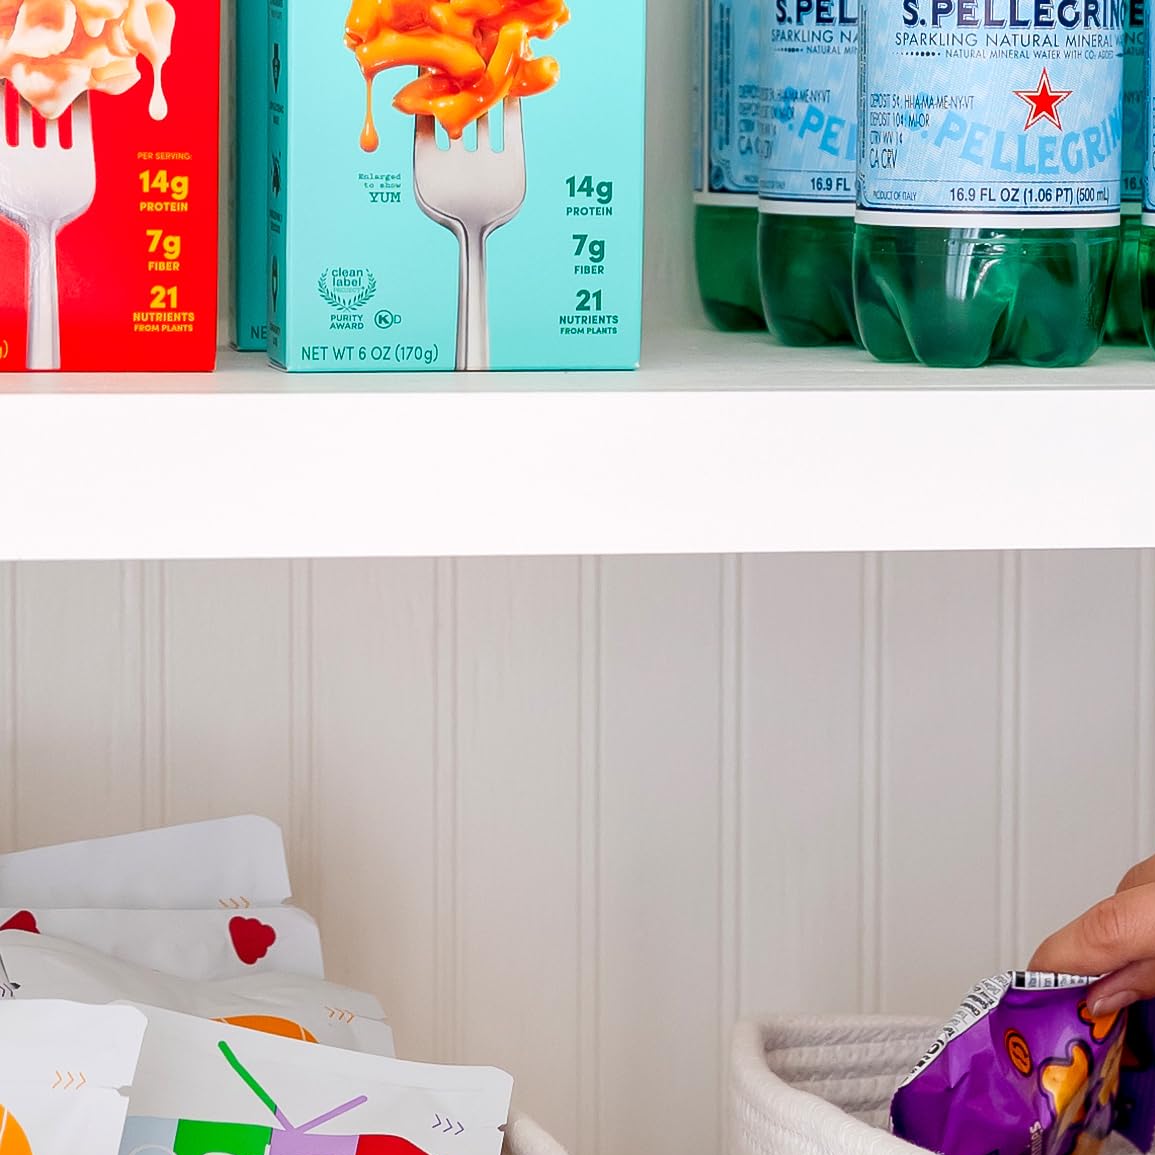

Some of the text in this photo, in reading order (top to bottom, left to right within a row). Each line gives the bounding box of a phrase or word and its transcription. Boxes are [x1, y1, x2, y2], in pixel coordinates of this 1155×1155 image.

[771, 29, 834, 43] SPARKLING
[895, 32, 978, 46] SPARKLING
[986, 33, 1059, 48] NATURAL
[1066, 34, 1112, 48] MINERAL
[806, 46, 840, 54] NATURAL
[945, 49, 986, 59] NATURAL
[990, 49, 1029, 59] MINERAL
[1033, 49, 1060, 59] WATER
[1064, 49, 1081, 59] WITH
[138, 152, 153, 160] PER
[358, 173, 401, 181] Enlarged
[139, 170, 189, 201] 14g
[810, 177, 850, 191] 16.9 FL
[566, 176, 613, 204] 14g
[369, 192, 400, 203] YUM
[950, 188, 976, 202] 16.9
[980, 188, 996, 201] FL
[1000, 188, 1019, 202] OZ
[1024, 188, 1052, 205] (1.06
[1055, 188, 1073, 204] PT)
[1076, 188, 1094, 204] (500
[140, 202, 188, 212] PROTEIN
[566, 207, 613, 216] PROTEIN
[146, 229, 181, 260] 7g
[572, 234, 605, 262] 7g
[148, 262, 180, 271] FIBER
[332, 267, 363, 277] clean
[574, 265, 604, 274] FIBER
[333, 276, 361, 286] label
[150, 285, 177, 308] 21
[576, 289, 602, 311] 21
[133, 312, 195, 322] NUTRIENTS
[559, 315, 618, 324] NUTRIENTS
[251, 326, 267, 339] NE
[302, 344, 438, 364] NET WT 6 OZ (170g)
